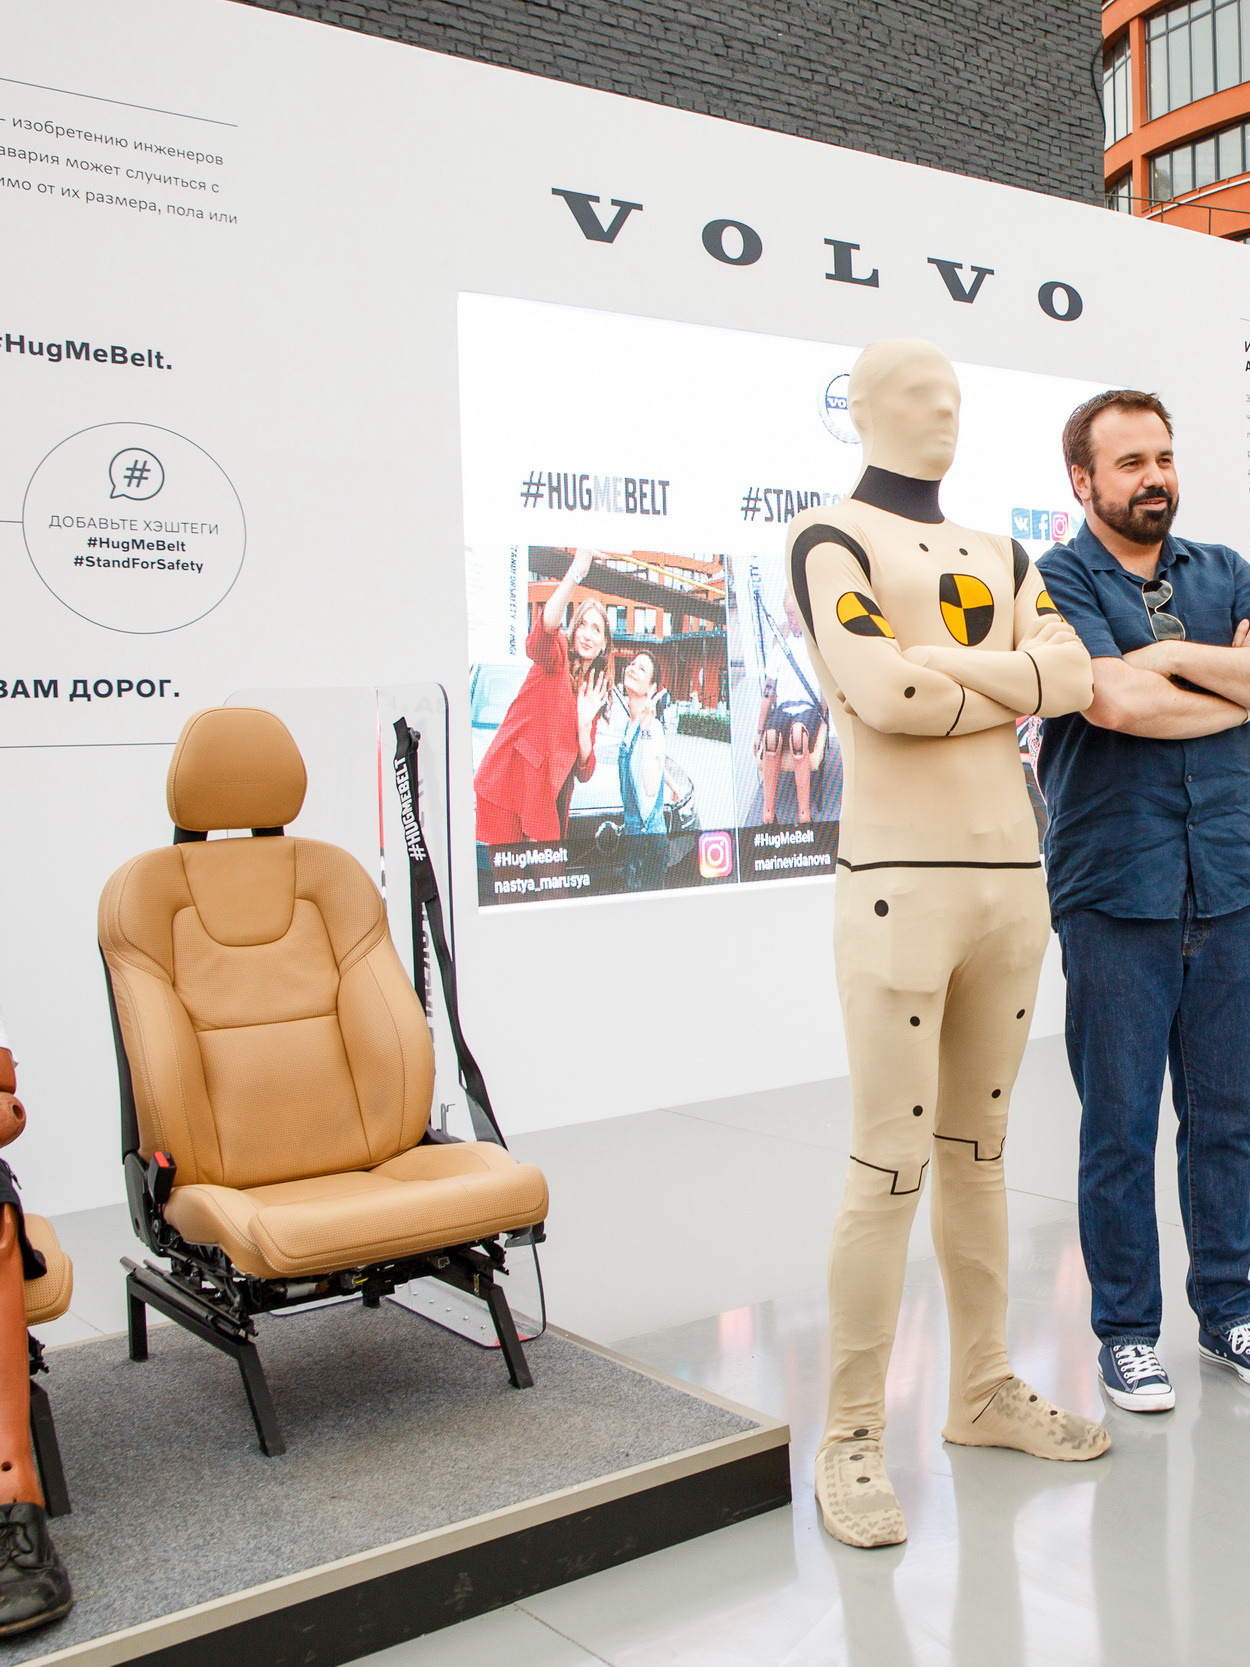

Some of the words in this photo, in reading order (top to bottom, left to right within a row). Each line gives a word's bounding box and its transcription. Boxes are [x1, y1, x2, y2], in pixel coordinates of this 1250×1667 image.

[12, 117, 128, 148] изобретению
[134, 140, 224, 165] инженеров
[66, 157, 121, 176] может
[126, 168, 206, 191] случиться
[212, 184, 220, 194] с
[38, 183, 55, 194] от
[61, 187, 80, 199] их
[86, 191, 161, 215] размера,
[167, 204, 204, 219] пола
[209, 211, 238, 224] или
[551, 187, 1084, 322] VOLVO
[0, 332, 173, 371] HugMeBelt.
[520, 470, 670, 516] #HUGMEBELT
[49, 514, 139, 531] ДОБАВЬТЕ
[143, 519, 219, 535] ХЭШТЕГИ
[87, 536, 186, 552] #HugMeBelt
[73, 555, 204, 574] #StandForSafety
[69, 678, 180, 702] ДОРОГ.
[394, 756, 427, 862] #HUGMEBELT
[754, 829, 815, 849] #HugMeBelt
[493, 847, 569, 869] #HugMeBelt
[754, 852, 831, 872] marinevidanova
[494, 873, 591, 895] nastya_marusya
